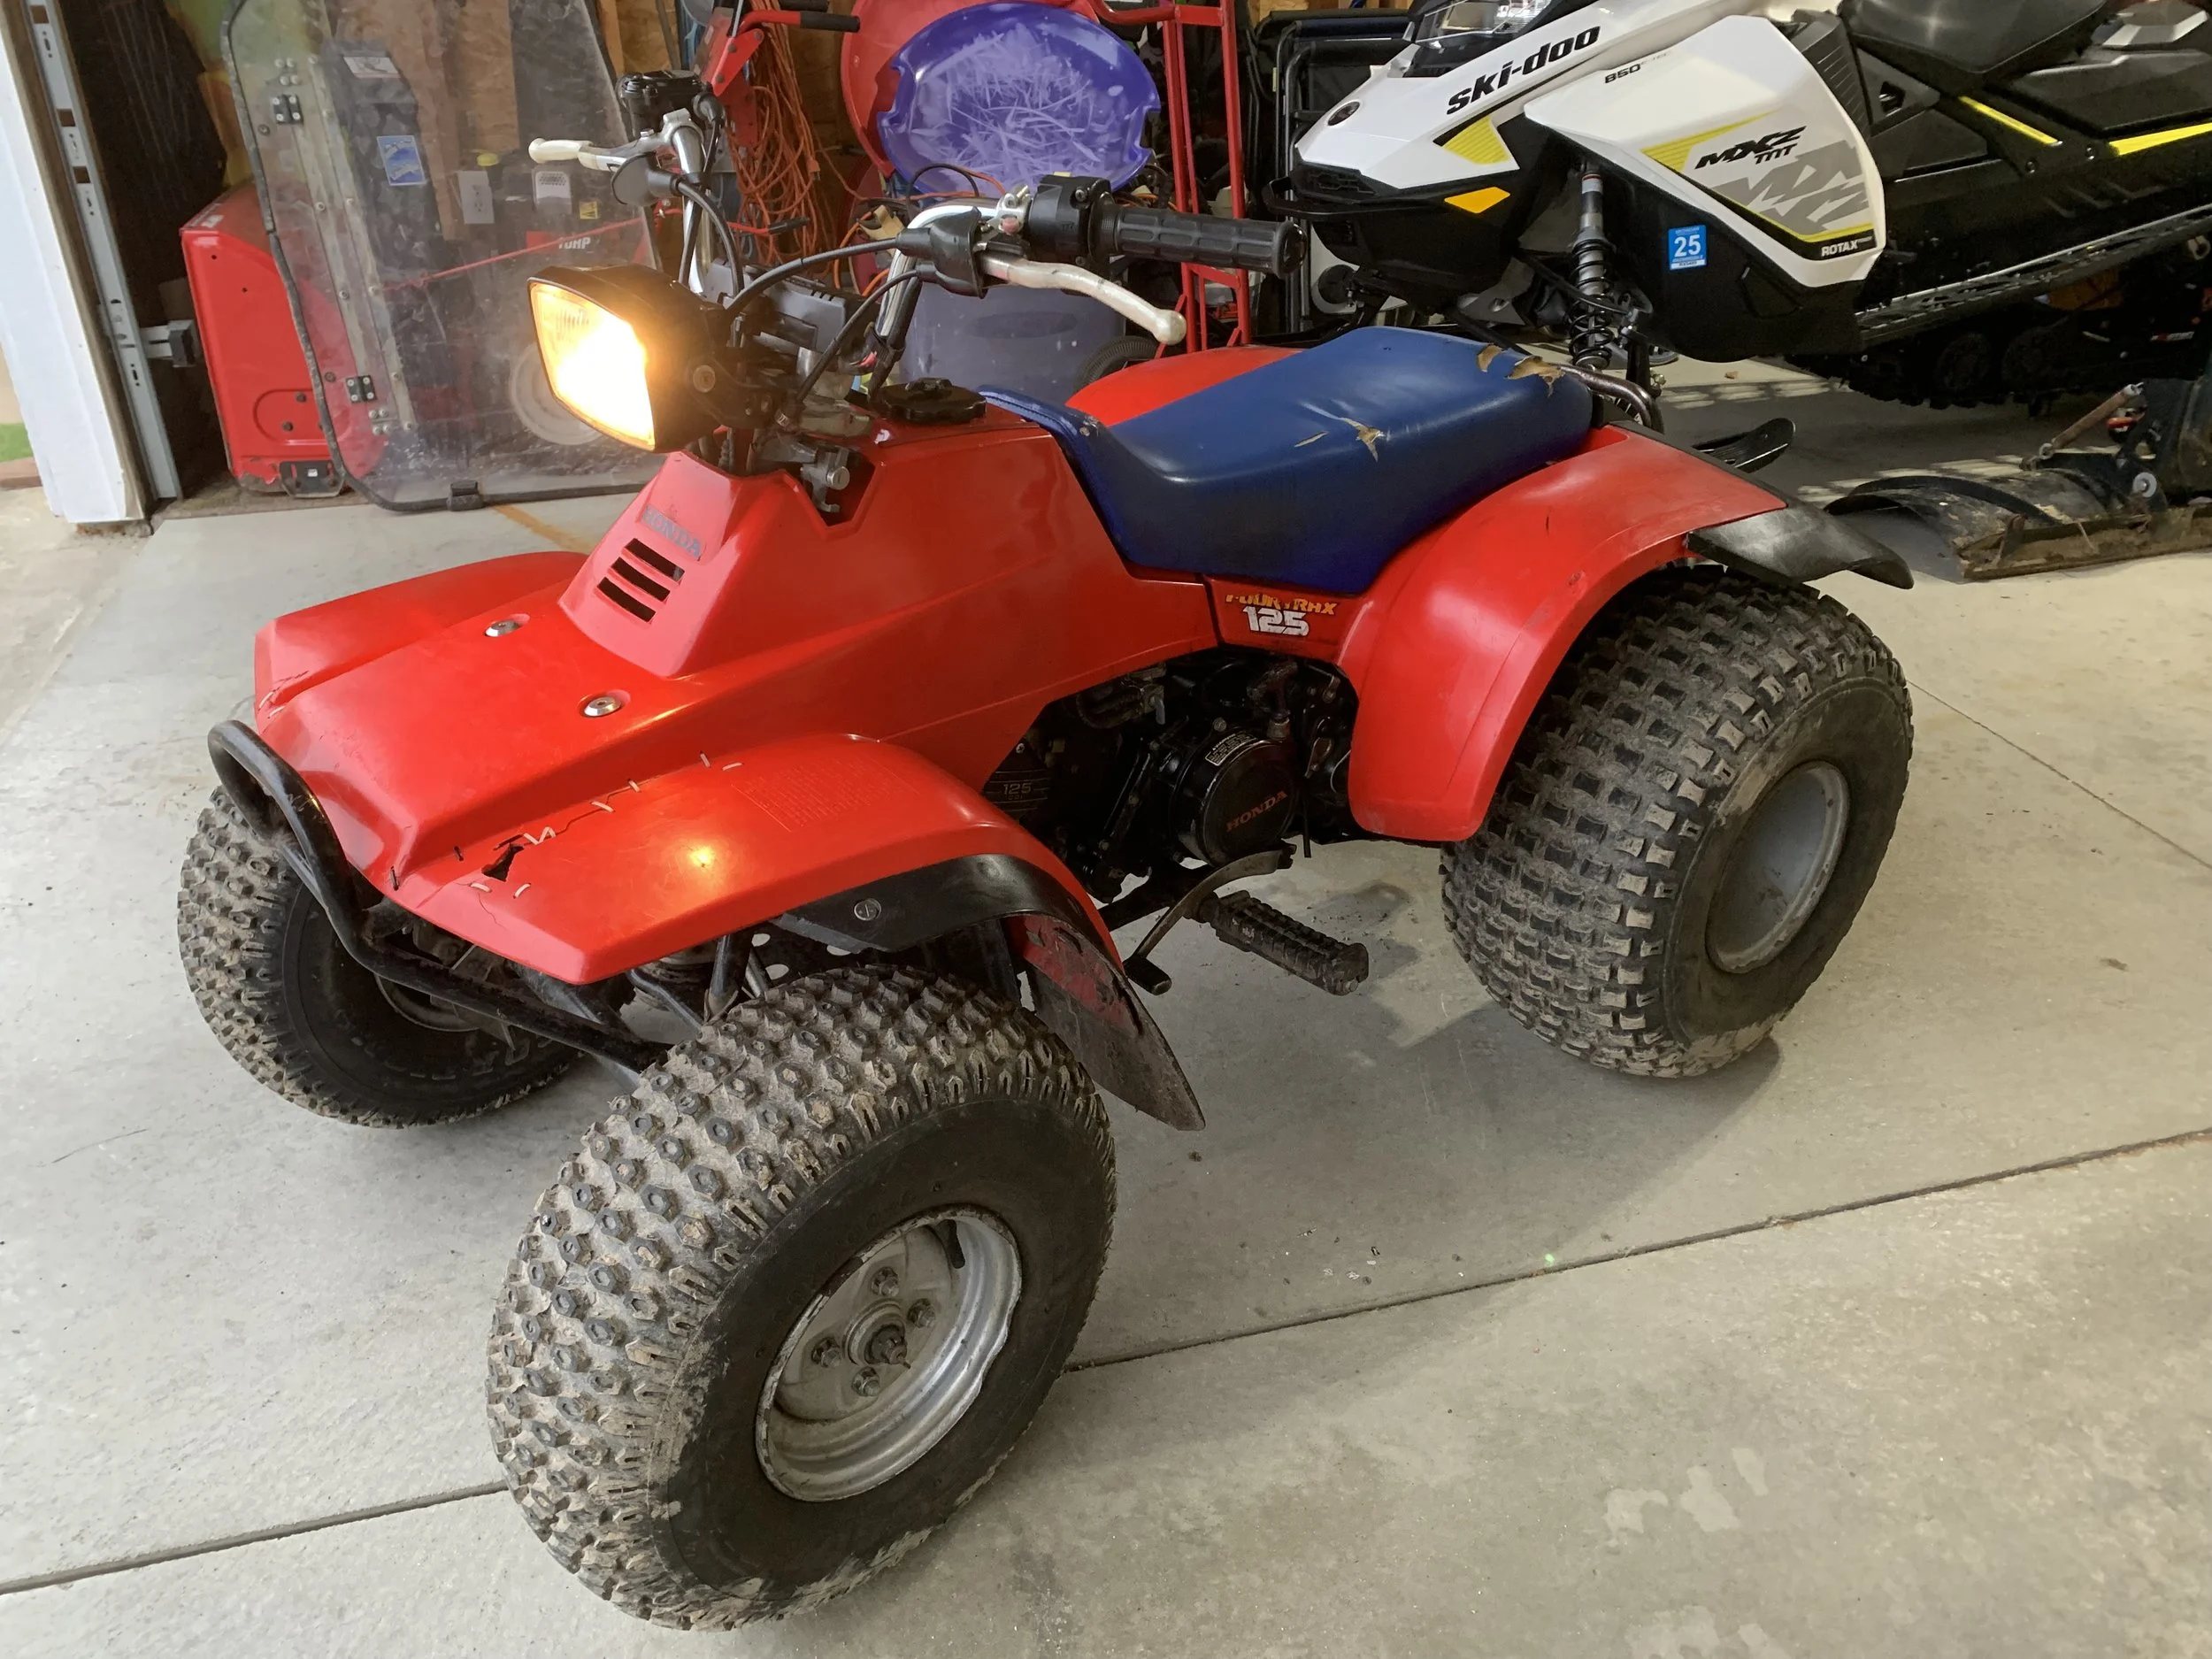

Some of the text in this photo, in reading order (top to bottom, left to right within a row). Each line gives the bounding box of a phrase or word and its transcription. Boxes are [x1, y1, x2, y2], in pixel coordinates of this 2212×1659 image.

[1447, 26, 1601, 115] ski-doo
[1604, 63, 1641, 83] 850
[1694, 126, 1807, 169] MXZ
[1674, 234, 1701, 257] 25
[1821, 239, 1859, 257] ROTAX
[641, 504, 702, 559] HONDA
[1225, 594, 1338, 616] OURRAX
[1242, 605, 1310, 636] 125
[1003, 782, 1033, 795] 125
[1226, 790, 1288, 833] HONDA
